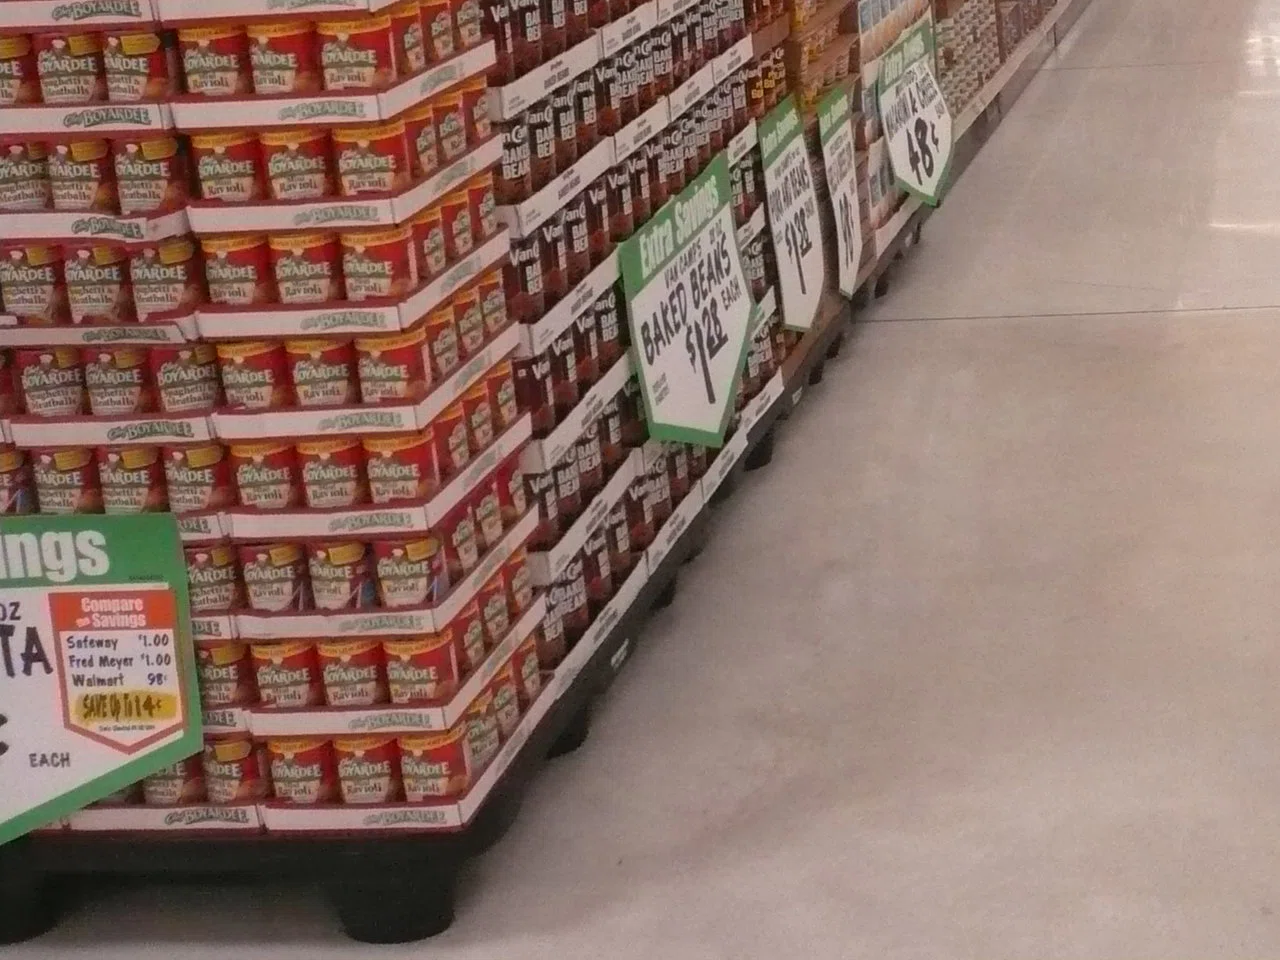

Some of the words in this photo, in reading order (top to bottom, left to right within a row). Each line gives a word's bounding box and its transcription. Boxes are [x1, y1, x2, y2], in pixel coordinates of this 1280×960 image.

[73, 0, 141, 20] BOYARDEE
[83, 107, 152, 127] BOYARDEE
[640, 218, 674, 280] Extra
[675, 175, 719, 245] Savings
[664, 262, 679, 289] VAN
[641, 282, 687, 366] BAKED
[690, 232, 731, 310] BEANS
[721, 275, 742, 311] EACH
[81, 597, 144, 613] Compare
[92, 613, 146, 628] Savings
[66, 635, 118, 650] Safeway
[69, 655, 94, 669] Fred
[99, 655, 134, 670] Meyer
[72, 673, 124, 687] Walmart
[82, 692, 107, 719] SAVE
[29, 753, 71, 769] EACH
